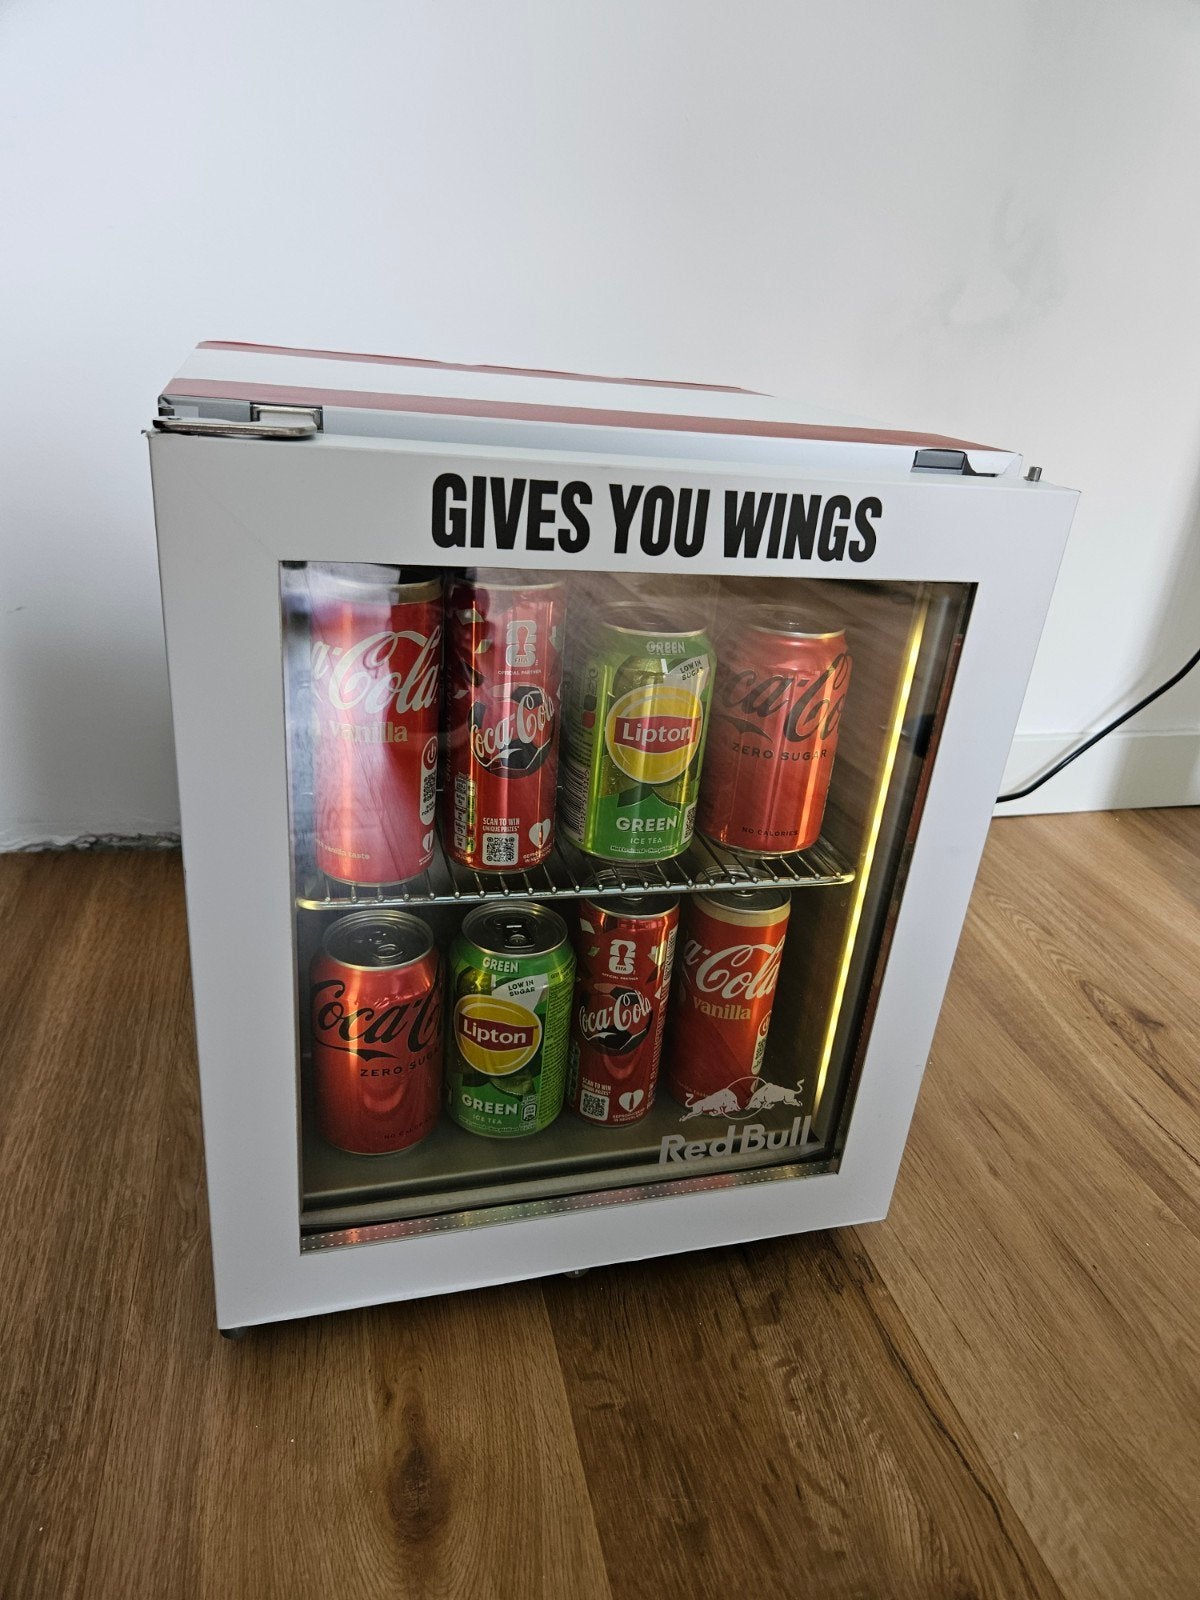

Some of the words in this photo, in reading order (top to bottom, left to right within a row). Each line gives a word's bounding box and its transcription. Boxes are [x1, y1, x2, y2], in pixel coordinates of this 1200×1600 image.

[431, 472, 593, 554] GIVES
[609, 483, 711, 558] YOU
[723, 490, 883, 563] WINGS
[646, 641, 686, 655] GREEN
[680, 664, 695, 674] LOW
[622, 722, 693, 746] Lipton
[732, 742, 775, 759] ZERO
[781, 749, 828, 762] SUGAR
[482, 817, 498, 825] SCAN
[499, 817, 507, 826] TO
[508, 817, 520, 826] WIN
[616, 815, 678, 833] GREEN
[742, 826, 755, 835] NO
[757, 829, 799, 837] CALORIES
[630, 837, 645, 845] ICE
[482, 957, 520, 974] GREEN
[507, 982, 525, 992] LOW
[525, 979, 535, 988] IN
[509, 986, 536, 997] SUGAR
[579, 989, 651, 1034] Coca-Cola
[692, 995, 751, 1020] vanilla
[463, 1018, 528, 1046] Lipton
[360, 1066, 403, 1077] ZERO
[601, 1083, 612, 1091] WIN
[461, 1093, 519, 1116] GREEN
[472, 1113, 486, 1122] ICE
[658, 1125, 736, 1165] Red
[739, 1115, 812, 1154] Bull
